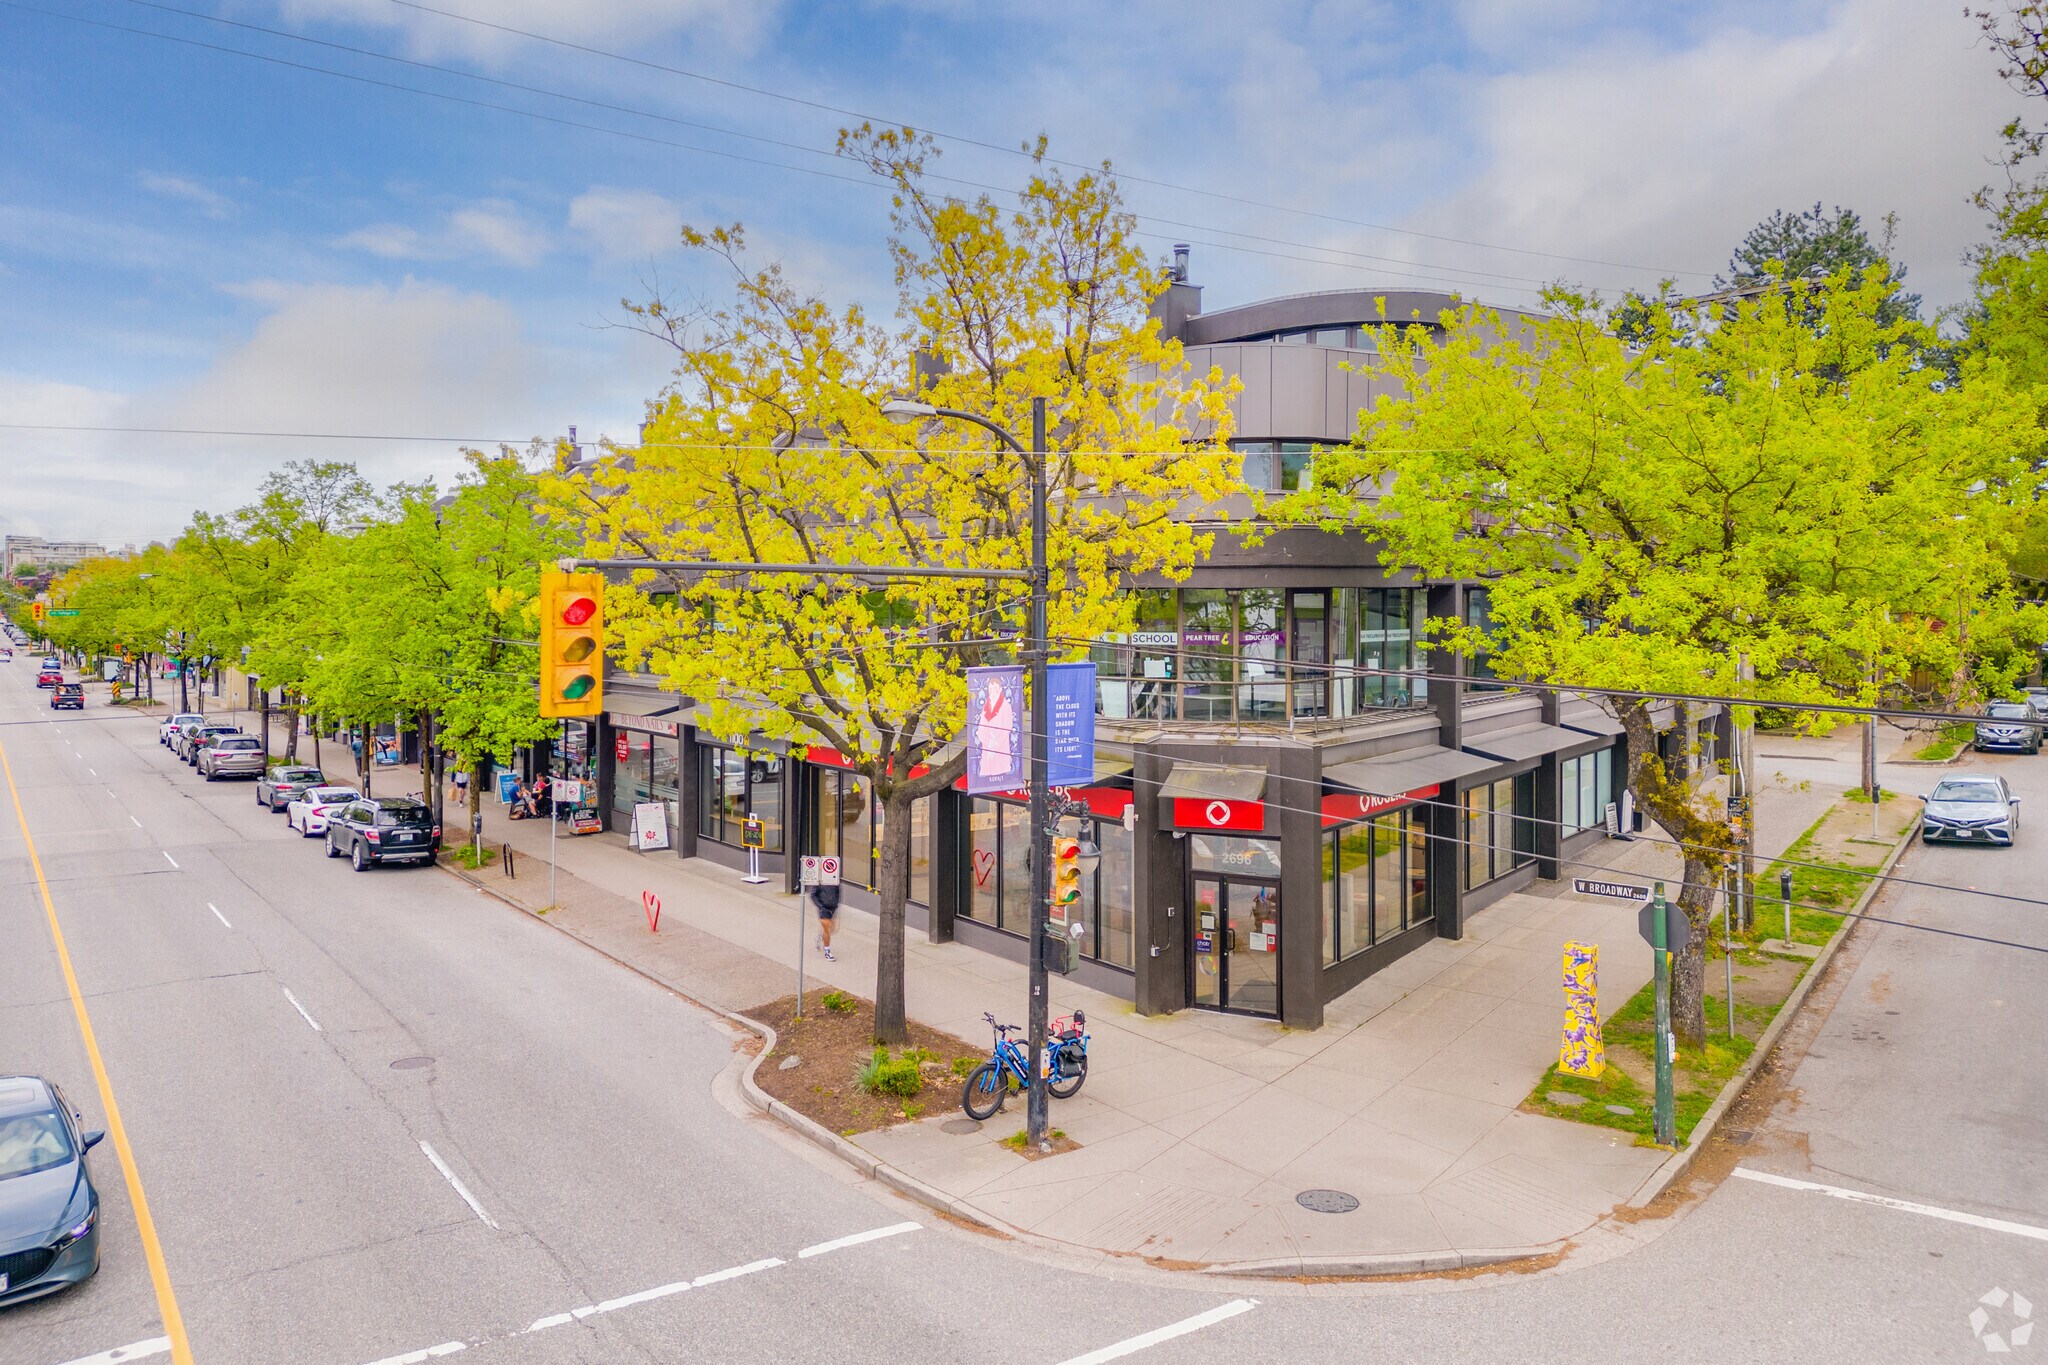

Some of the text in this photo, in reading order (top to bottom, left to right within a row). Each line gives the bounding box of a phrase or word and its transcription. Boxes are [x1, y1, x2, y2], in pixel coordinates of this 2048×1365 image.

[1132, 632, 1176, 643] SCHOOL
[645, 717, 664, 731] NAILS
[1221, 852, 1252, 866] 2696
[1578, 881, 1586, 892] W
[1589, 883, 1633, 898] BROADWAY
